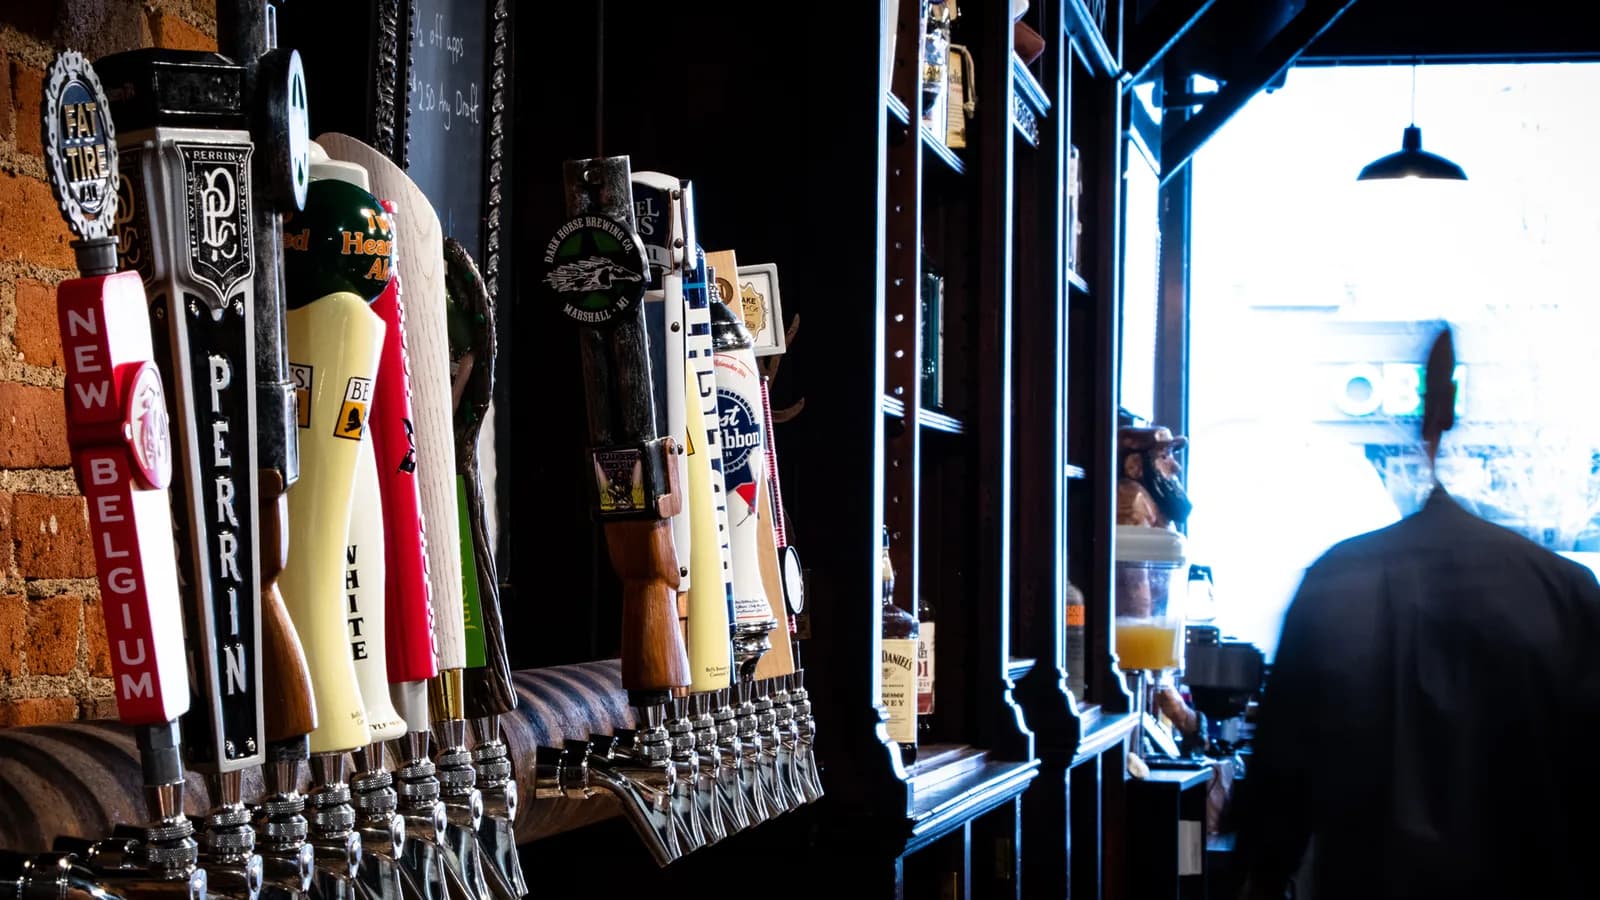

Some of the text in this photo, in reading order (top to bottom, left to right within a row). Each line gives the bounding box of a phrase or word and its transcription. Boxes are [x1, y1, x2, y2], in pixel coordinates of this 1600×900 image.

[429, 13, 443, 49] off
[446, 36, 464, 64] apps
[64, 102, 97, 138] FAT
[66, 143, 110, 182] TIRE
[193, 150, 235, 161] PERRIN
[239, 173, 249, 258] COMPANY
[361, 208, 390, 235] Tw
[341, 231, 392, 256] Hear
[544, 235, 561, 264] DARK
[557, 217, 584, 241] HORSE
[585, 216, 625, 241] BREWING
[563, 296, 630, 323] MARSHALL MI
[67, 307, 109, 409] NEW
[208, 352, 247, 695] PERRIN
[91, 458, 153, 699] BELGIUM
